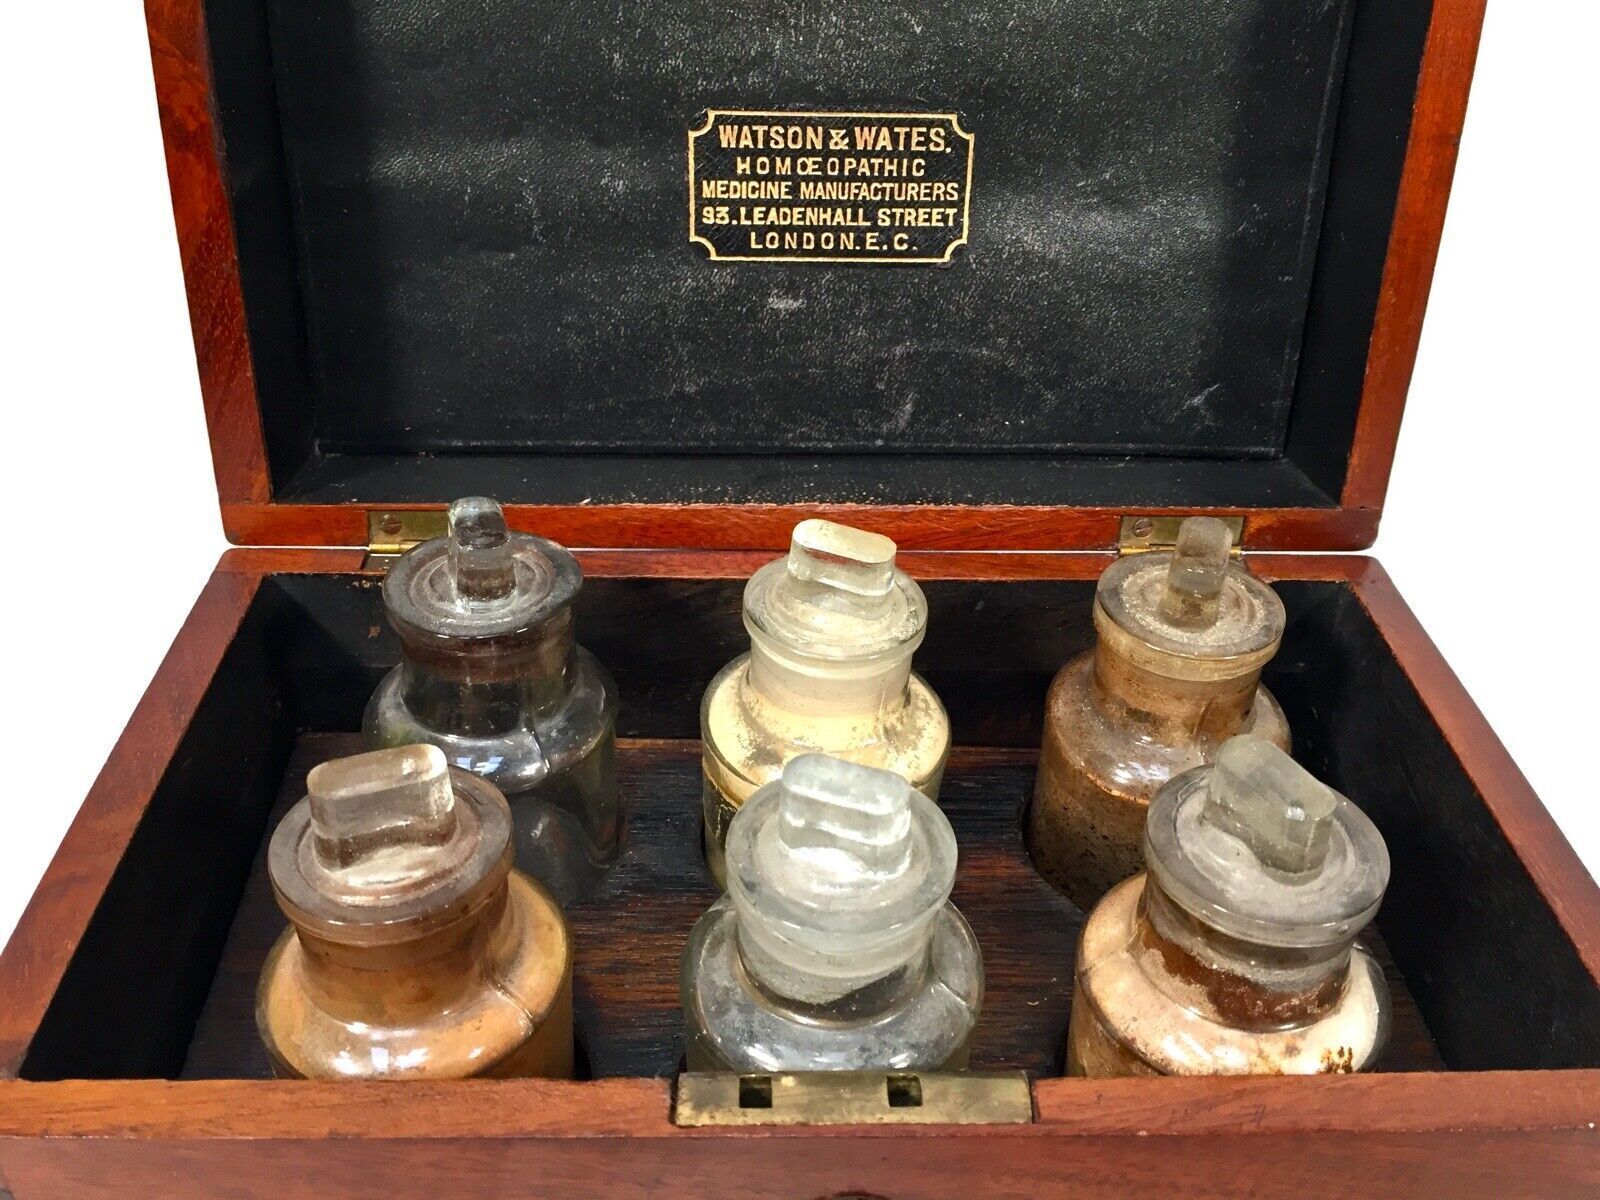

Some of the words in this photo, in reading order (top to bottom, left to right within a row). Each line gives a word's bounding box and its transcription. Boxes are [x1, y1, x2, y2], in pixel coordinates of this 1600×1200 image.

[718, 125, 824, 150] WATSON
[829, 129, 849, 150] &
[854, 126, 952, 153] WATES.
[702, 180, 792, 200] MEDICINE
[800, 181, 959, 201] MANUFACTURERS
[877, 207, 958, 227] STREET
